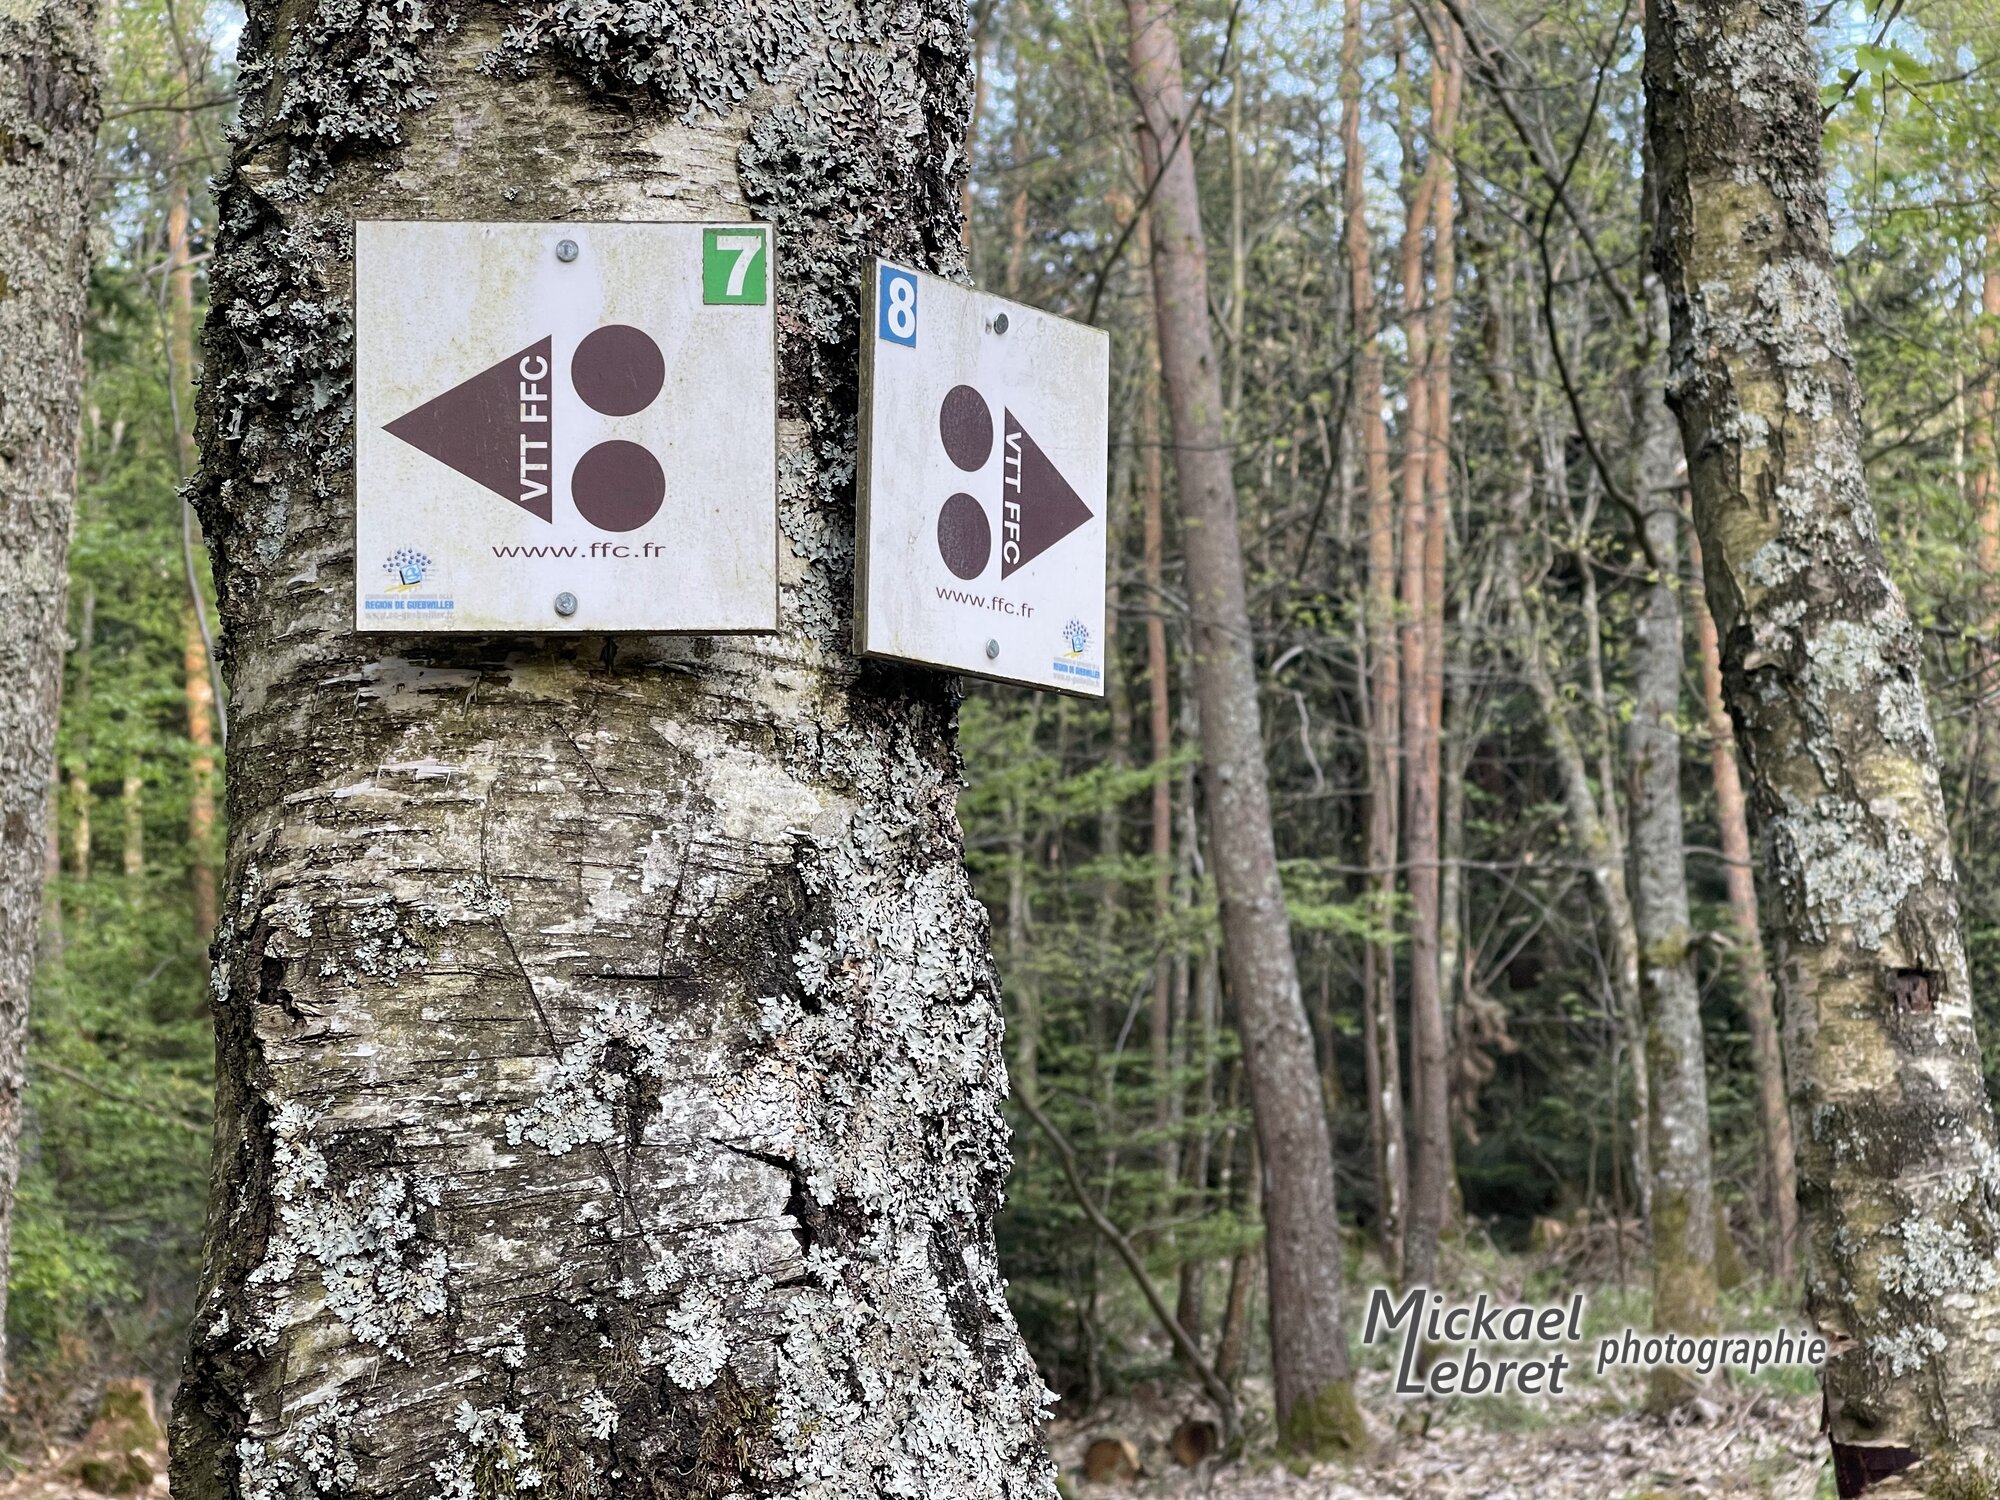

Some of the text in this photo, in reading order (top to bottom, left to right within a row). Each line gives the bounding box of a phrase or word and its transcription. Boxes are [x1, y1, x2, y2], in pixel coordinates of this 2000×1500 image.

[715, 235, 762, 296] 7
[887, 277, 916, 339] 8
[519, 355, 549, 501] VTT FFC
[1003, 431, 1022, 565] VTT FFC
[492, 542, 667, 558] www.ffc.fr
[365, 601, 454, 609] REGION DE GUEBWILLER
[935, 586, 1034, 619] www.ffc.fr
